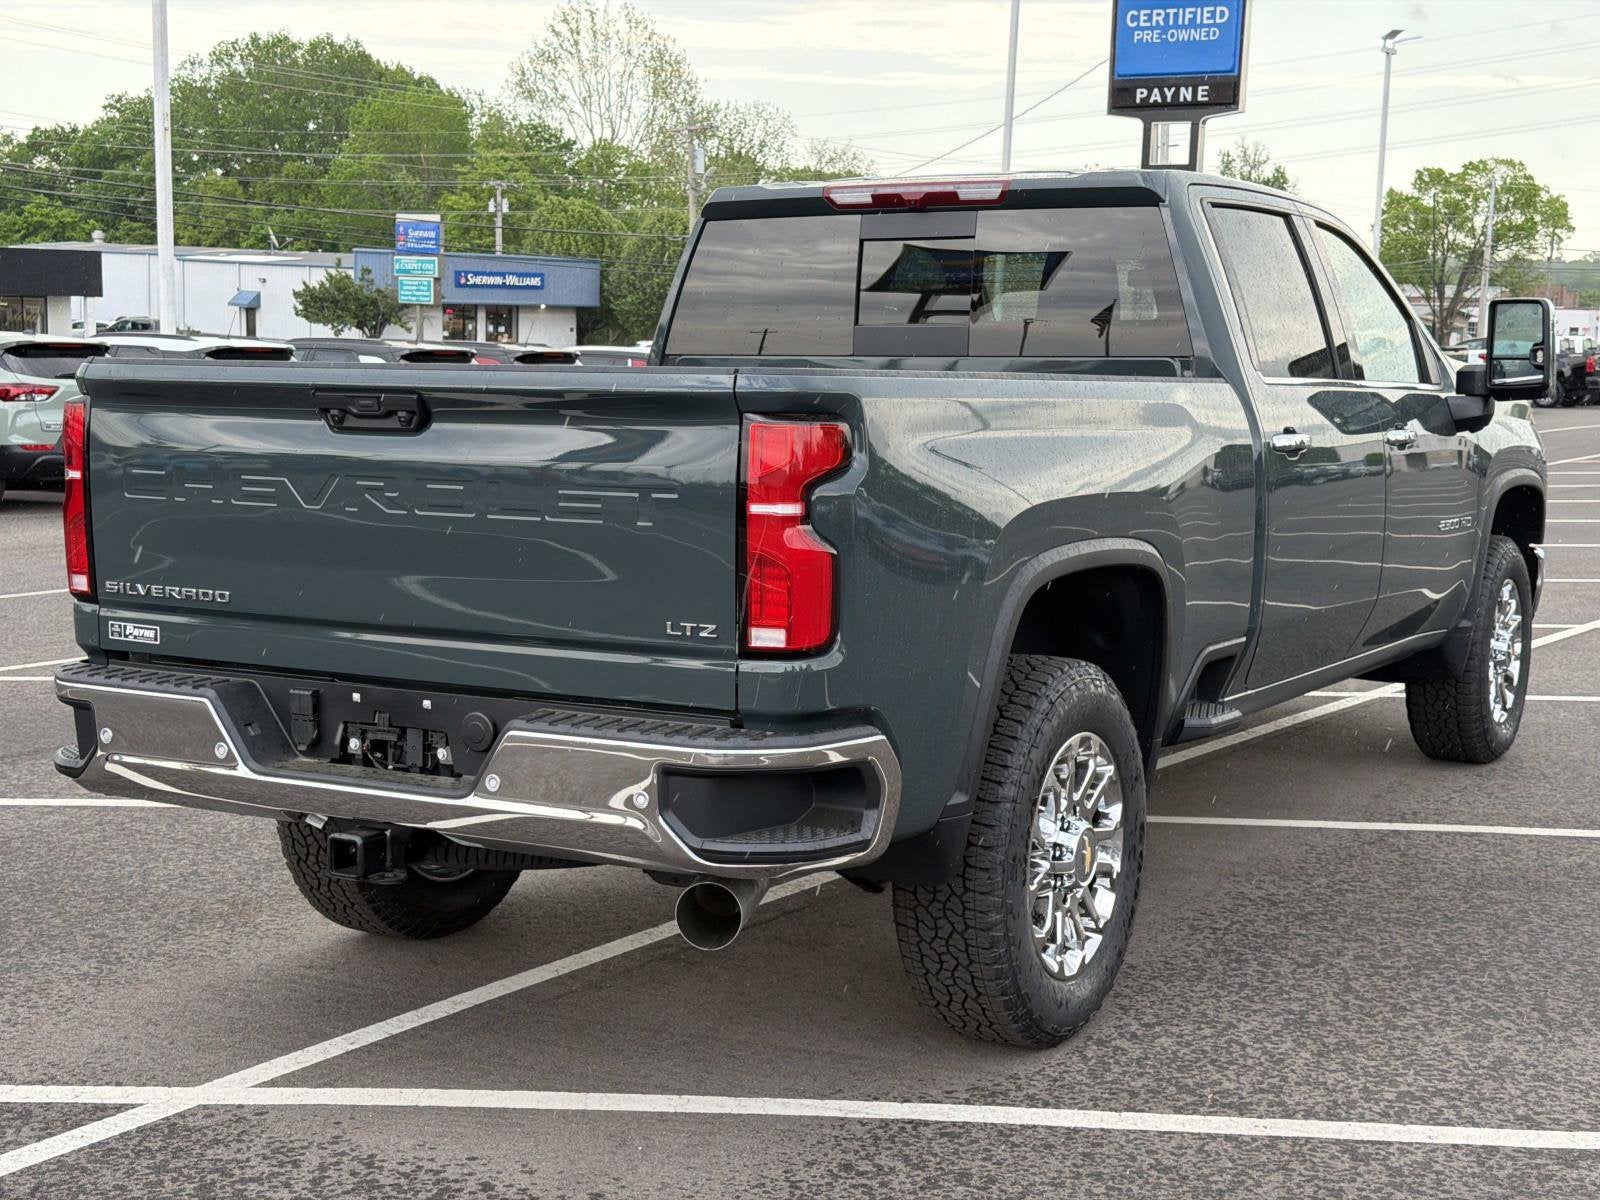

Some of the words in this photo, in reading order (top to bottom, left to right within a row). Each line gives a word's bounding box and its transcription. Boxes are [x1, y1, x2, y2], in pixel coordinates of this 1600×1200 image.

[1126, 6, 1230, 27] CERTIFIED
[1133, 27, 1220, 44] PRE-OWNED
[1135, 85, 1210, 104] PAYNE
[466, 273, 542, 286] SHERWIN-WILLIAMS
[123, 467, 679, 526] CHEVROLET
[104, 580, 230, 602] SILVERADO
[125, 625, 156, 638] PAYNE
[666, 621, 718, 638] LTZ
